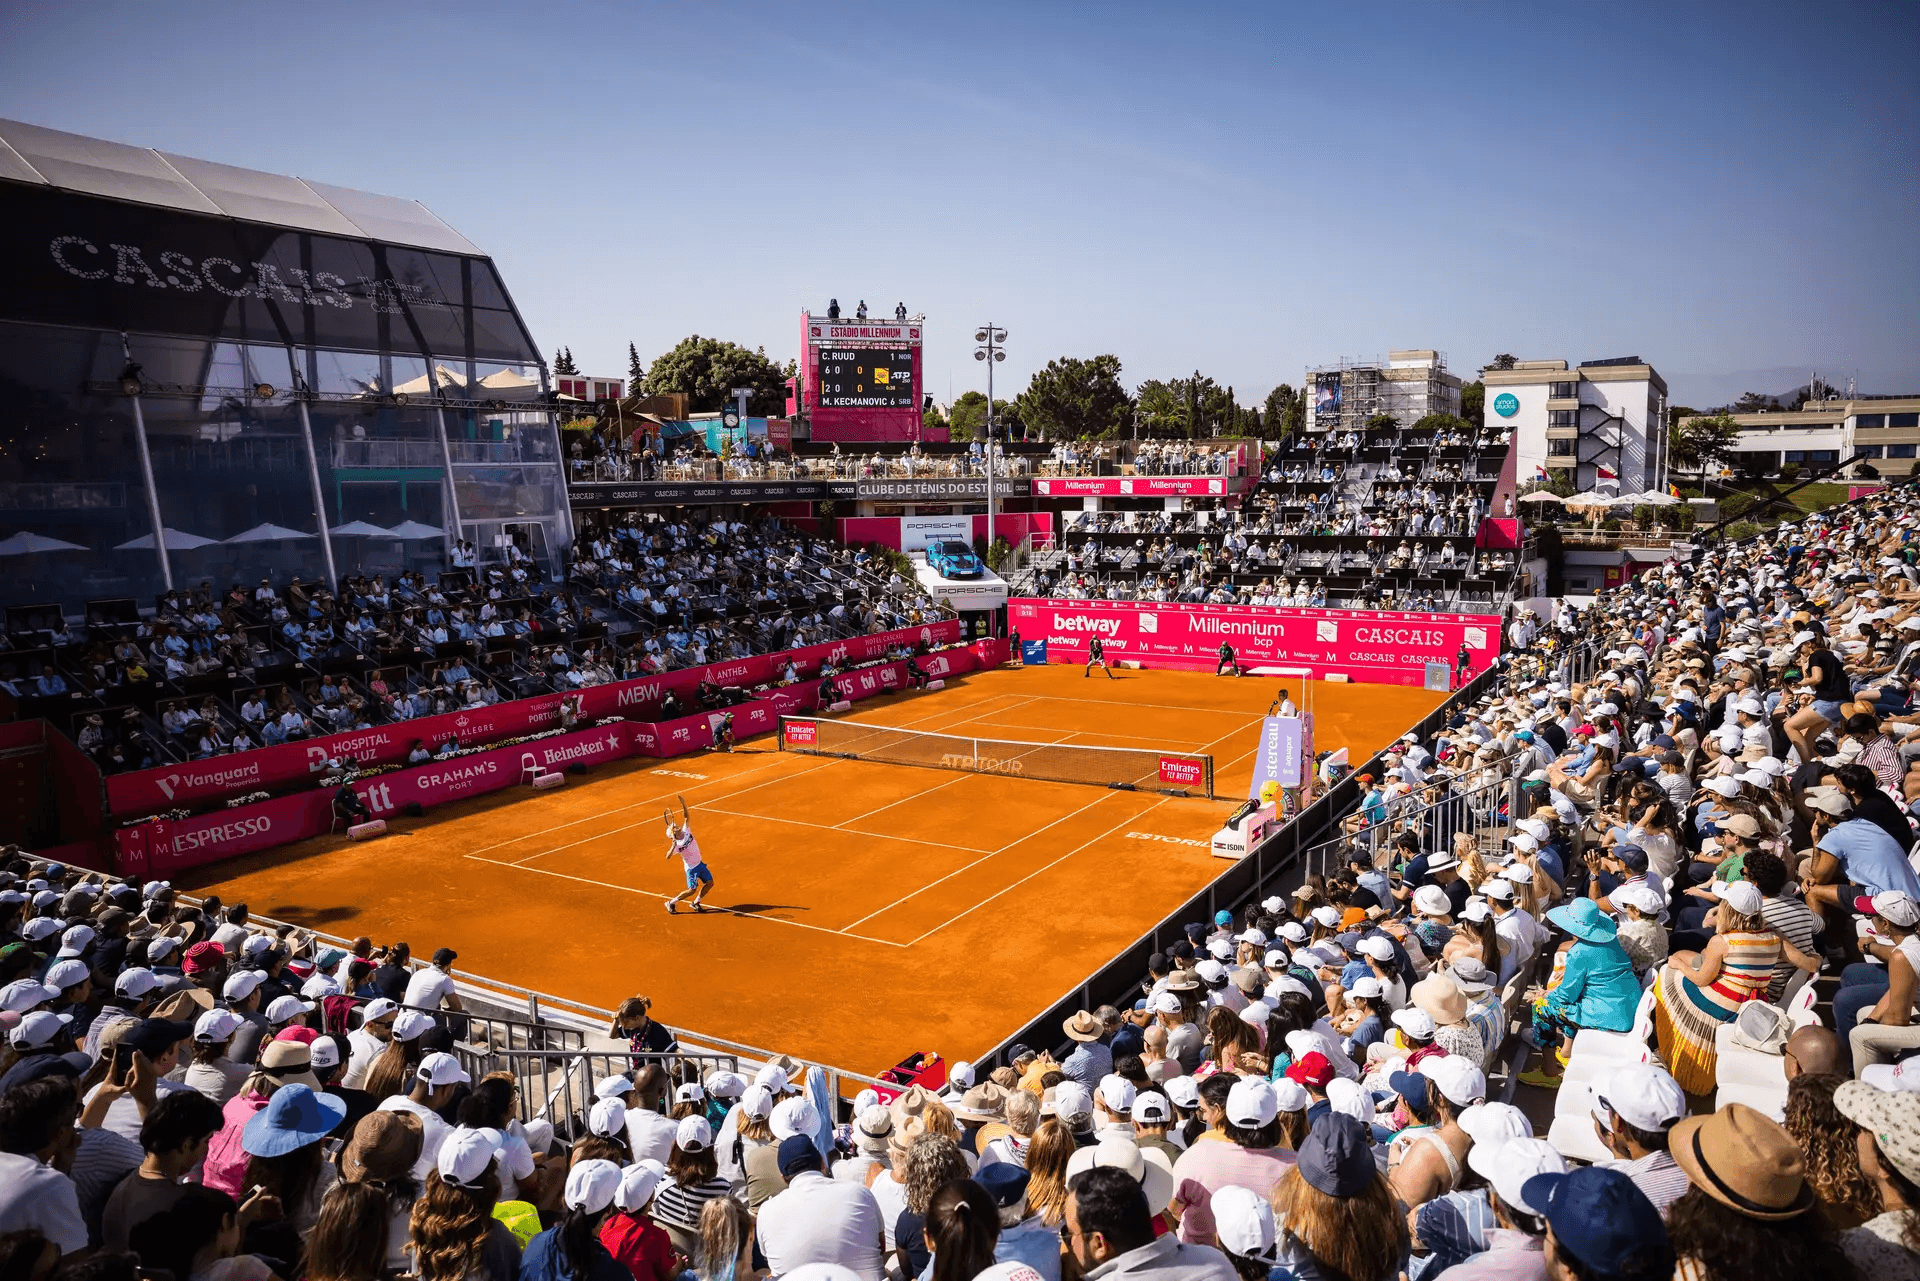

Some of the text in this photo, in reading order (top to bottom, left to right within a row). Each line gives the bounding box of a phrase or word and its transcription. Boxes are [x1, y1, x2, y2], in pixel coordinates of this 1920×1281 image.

[50, 236, 352, 309] CASCAIS
[357, 276, 423, 292] The Charm
[366, 289, 443, 307] of the Atlantic
[370, 302, 405, 314] Coast
[860, 327, 901, 339] MILLENNIUM
[822, 352, 855, 360] C. RUUD
[890, 353, 895, 361] 1
[825, 366, 840, 374] 6 0
[857, 366, 863, 374] 0
[825, 384, 840, 392] 2 0
[857, 384, 863, 392] 0
[822, 397, 887, 406] M. KECMANOVIC
[890, 397, 895, 405] 6
[858, 484, 894, 495] CLUBE
[897, 484, 912, 494] DE
[914, 482, 946, 494] TÉNIS
[948, 483, 966, 493] DO
[1065, 481, 1104, 489] Millennium
[1150, 480, 1192, 489] Millennium
[612, 491, 639, 499] CASCAIS
[730, 488, 752, 496] CASCAIS
[938, 586, 1003, 594] PORSCHE
[1054, 613, 1121, 636] betway
[1188, 613, 1284, 636] Millennium
[1048, 635, 1080, 648] betway
[1254, 636, 1273, 648] bcp
[1355, 627, 1444, 647] CASCAIS
[1100, 638, 1127, 650] etway
[1139, 640, 1149, 651] M
[1183, 643, 1193, 653] M
[1277, 648, 1287, 659] M
[1326, 651, 1336, 662] M
[1349, 651, 1395, 663] CASCAIS
[1401, 654, 1448, 665] CASCAIS
[717, 665, 748, 680] ANTHEA
[880, 668, 897, 682] CNN
[861, 671, 876, 689] tvi
[618, 682, 660, 707] MBW
[528, 709, 562, 724] PORTUGA
[432, 723, 494, 742] VISTA ALEGRE
[672, 728, 689, 739] ATP
[787, 725, 816, 734] Emirates
[333, 732, 390, 754] HOSPITAL
[635, 733, 655, 743] ATP
[355, 749, 378, 762] LUZ
[543, 739, 605, 765] Heineken
[1266, 723, 1279, 777] stereau
[977, 756, 1023, 775] TOUR
[1161, 761, 1200, 774] Emirates
[183, 762, 259, 787] Vanguard
[417, 760, 497, 789] GRAHAM'S
[226, 777, 261, 788] Properties
[449, 780, 472, 791] PORT
[131, 830, 139, 839] 4
[156, 825, 164, 834] 3
[1124, 831, 1212, 848] ESTORIL
[130, 849, 143, 861] M
[156, 843, 168, 855] M
[881, 1092, 892, 1107] 2
